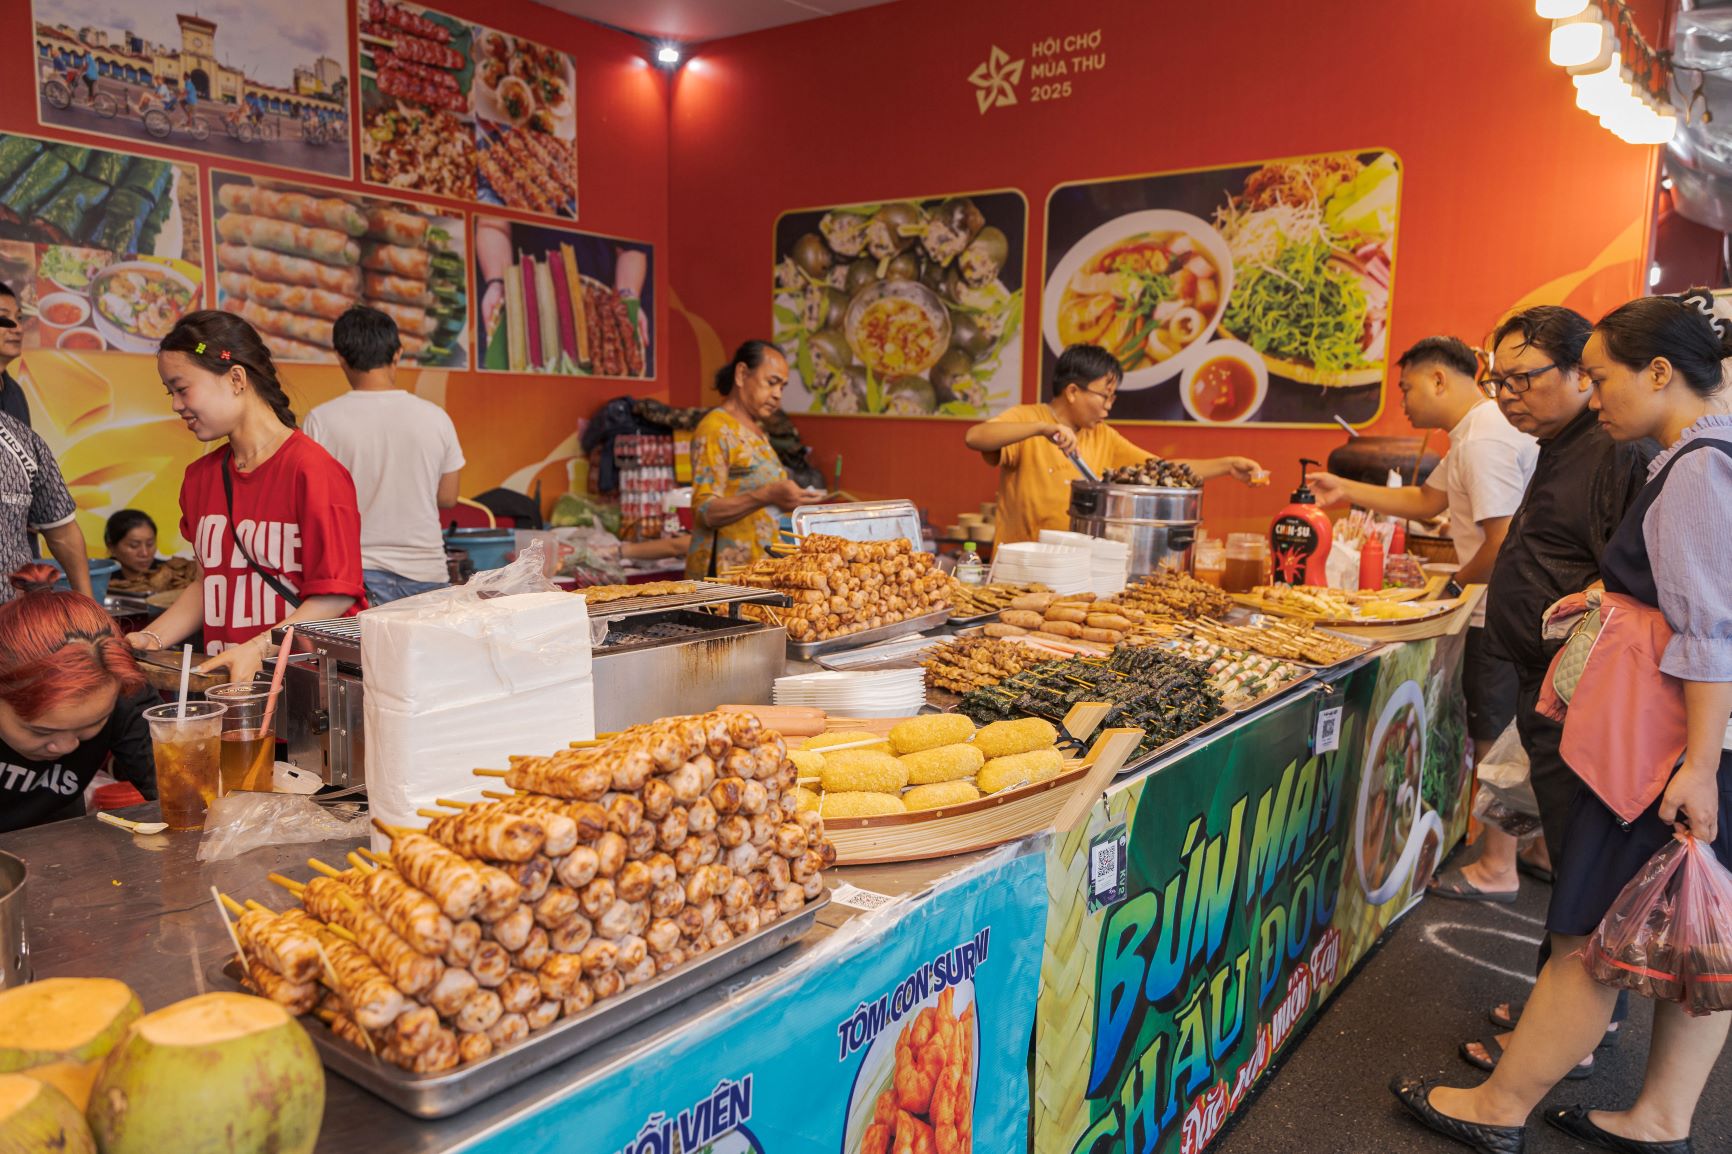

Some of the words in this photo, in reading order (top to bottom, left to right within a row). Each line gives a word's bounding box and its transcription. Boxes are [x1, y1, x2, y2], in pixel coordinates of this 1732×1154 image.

[1031, 37, 1060, 58] HỘI
[1063, 29, 1101, 51] CHỢ
[1072, 53, 1106, 73] THU
[1031, 81, 1073, 102] 2025
[1088, 794, 1248, 1099] BÚN
[1258, 836, 1340, 1009] ĐỐC
[838, 995, 888, 1061] TÔM
[890, 963, 930, 1022] CON
[679, 1076, 752, 1153] VIÊN
